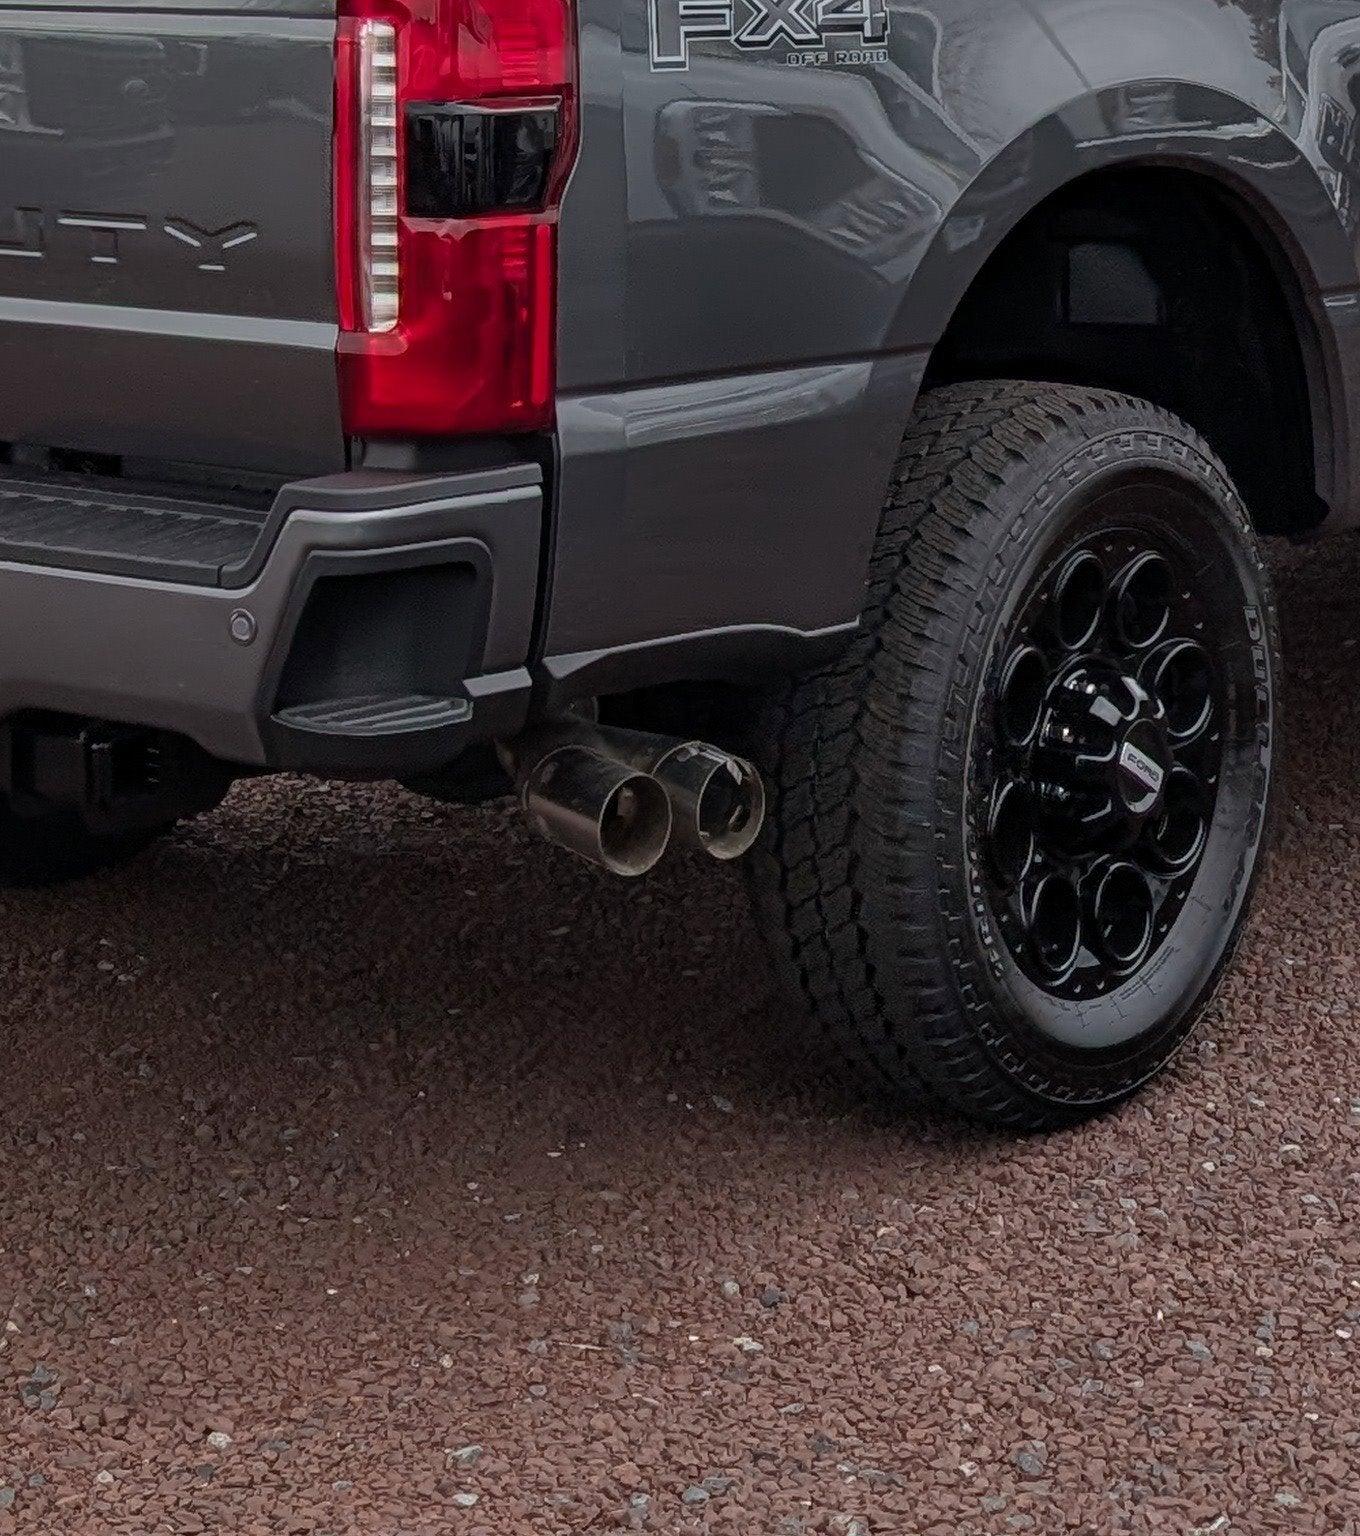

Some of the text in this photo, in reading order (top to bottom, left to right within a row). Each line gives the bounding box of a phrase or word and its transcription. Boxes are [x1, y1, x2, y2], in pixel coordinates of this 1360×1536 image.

[786, 49, 889, 67] OFF ROAD
[1126, 752, 1161, 783] FORD
